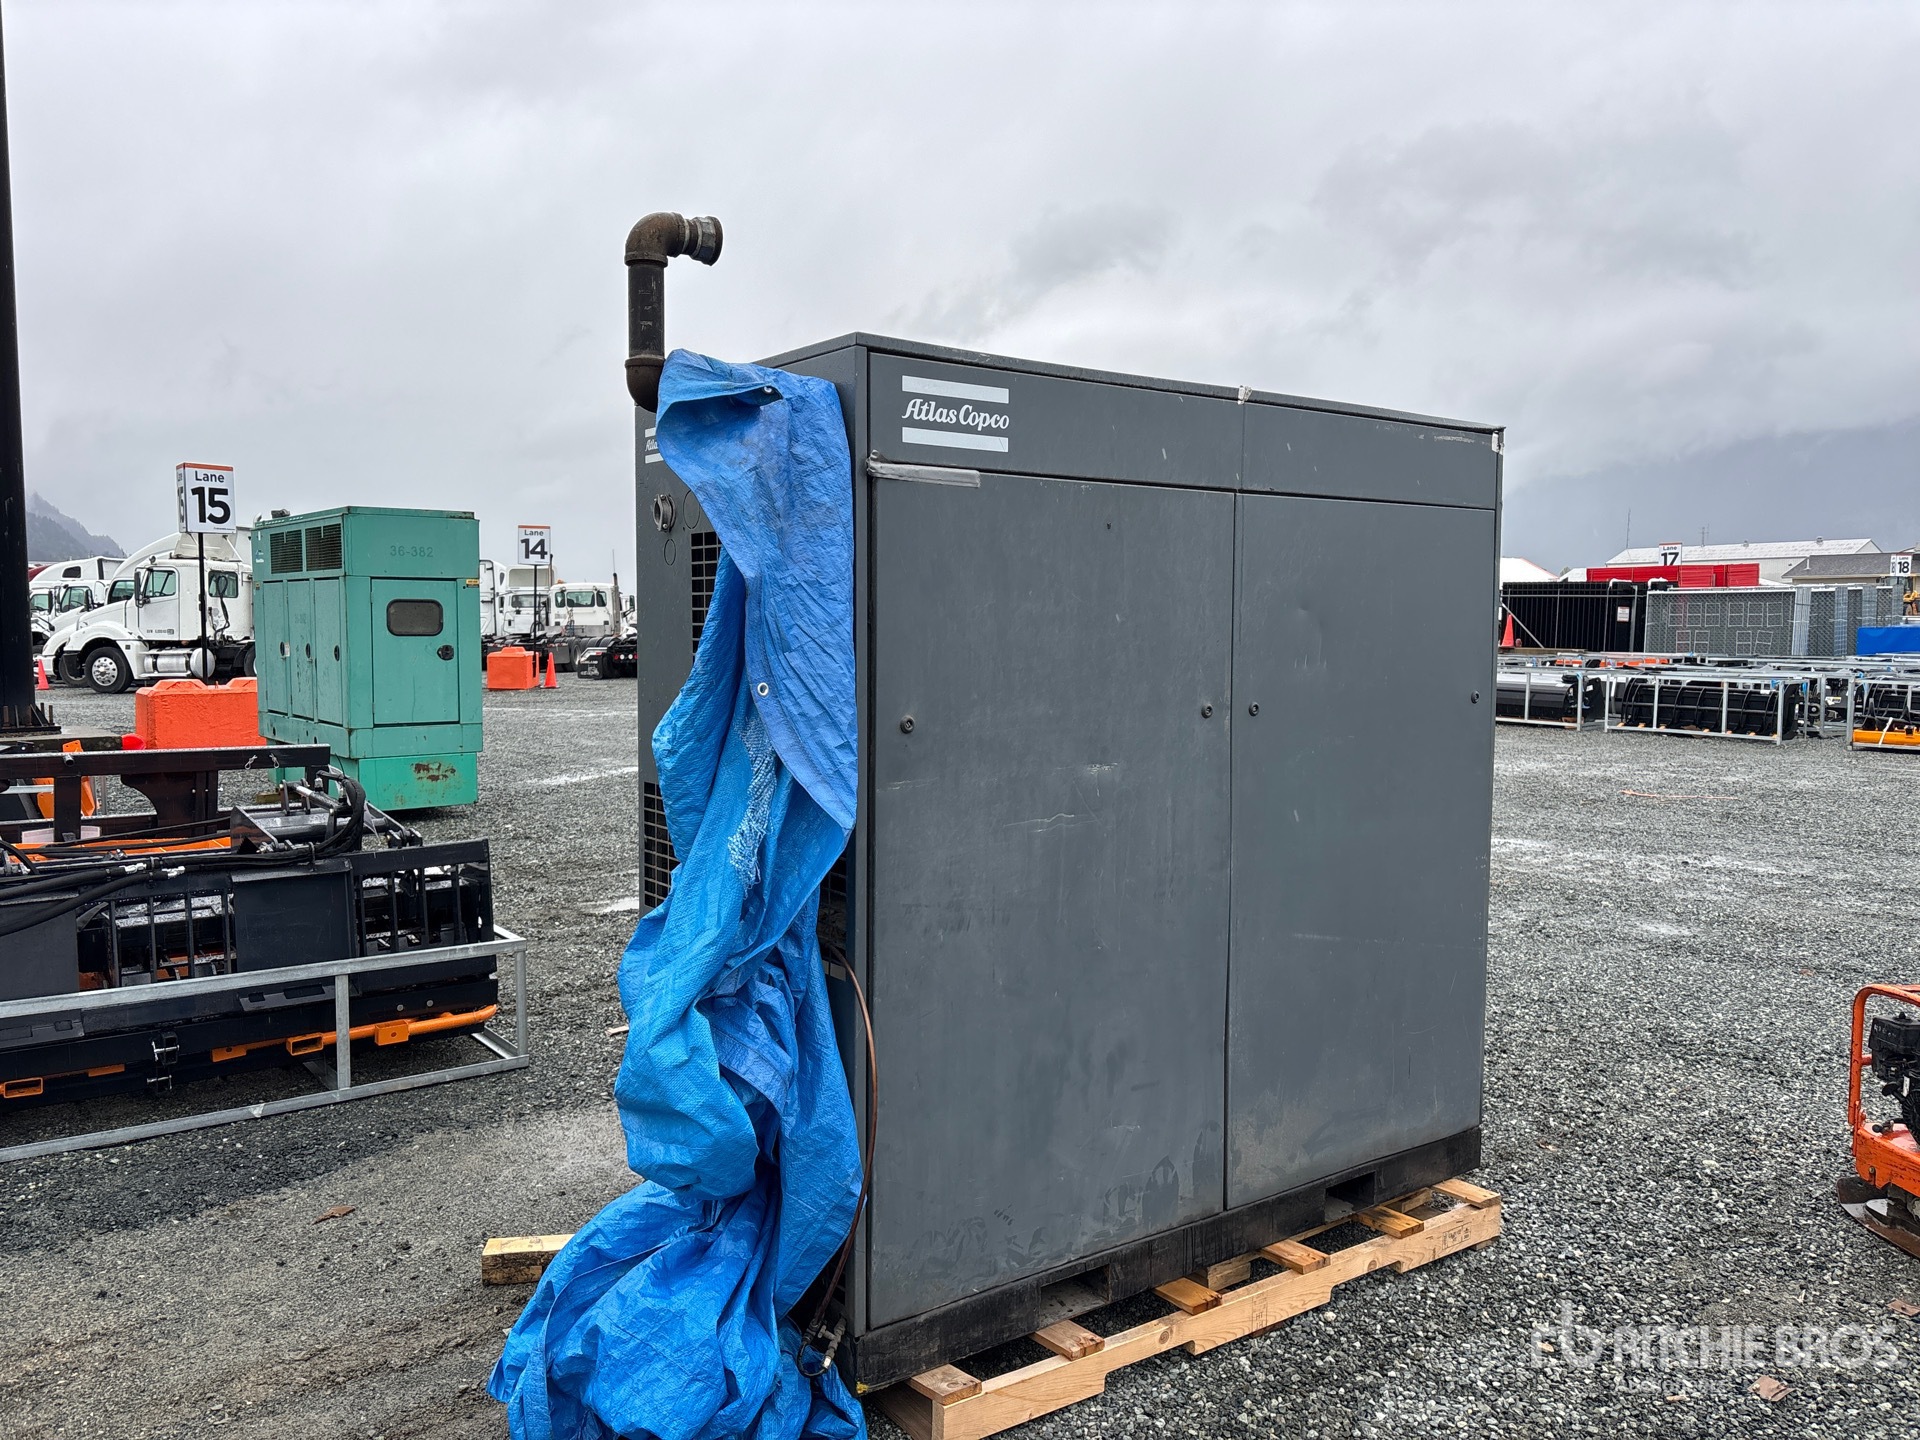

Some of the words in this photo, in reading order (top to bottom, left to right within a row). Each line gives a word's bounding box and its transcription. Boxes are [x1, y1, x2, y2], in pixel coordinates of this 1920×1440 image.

[901, 398, 957, 424] Atlas
[959, 404, 1010, 431] Copco
[194, 470, 225, 483] Lane
[190, 486, 231, 525] 15
[390, 545, 434, 558] 36-382
[520, 537, 548, 560] 14
[1660, 551, 1680, 566] 17
[1897, 561, 1910, 574] 18
